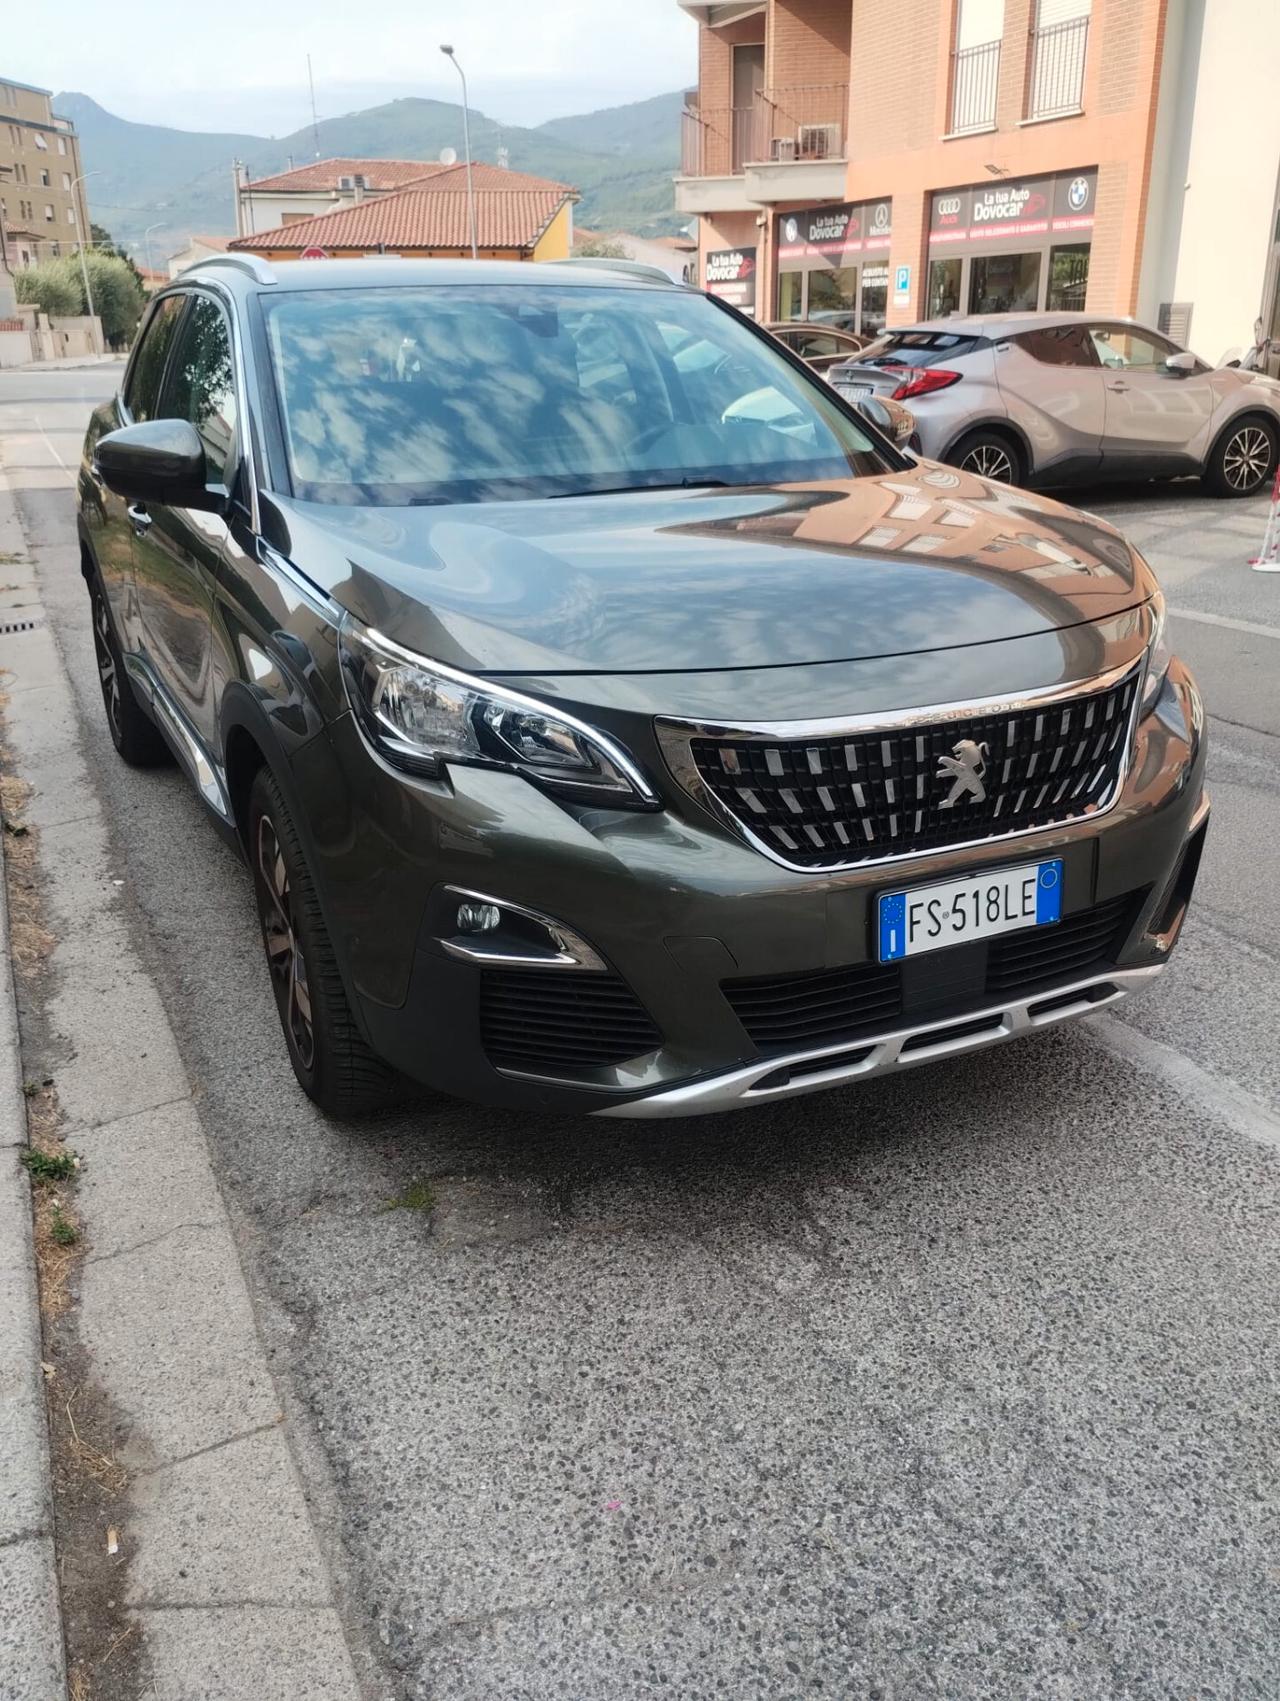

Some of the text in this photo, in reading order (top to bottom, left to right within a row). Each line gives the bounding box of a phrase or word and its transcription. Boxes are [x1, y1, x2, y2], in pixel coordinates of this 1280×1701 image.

[984, 189, 1030, 205] La tua Auto
[974, 201, 1024, 221] Dovocar
[816, 217, 824, 227] La
[835, 214, 849, 224] Auto
[809, 225, 844, 240] Dovocar
[707, 263, 739, 280] Dovocar
[909, 899, 941, 943] FS
[952, 878, 1036, 931] 518LE
